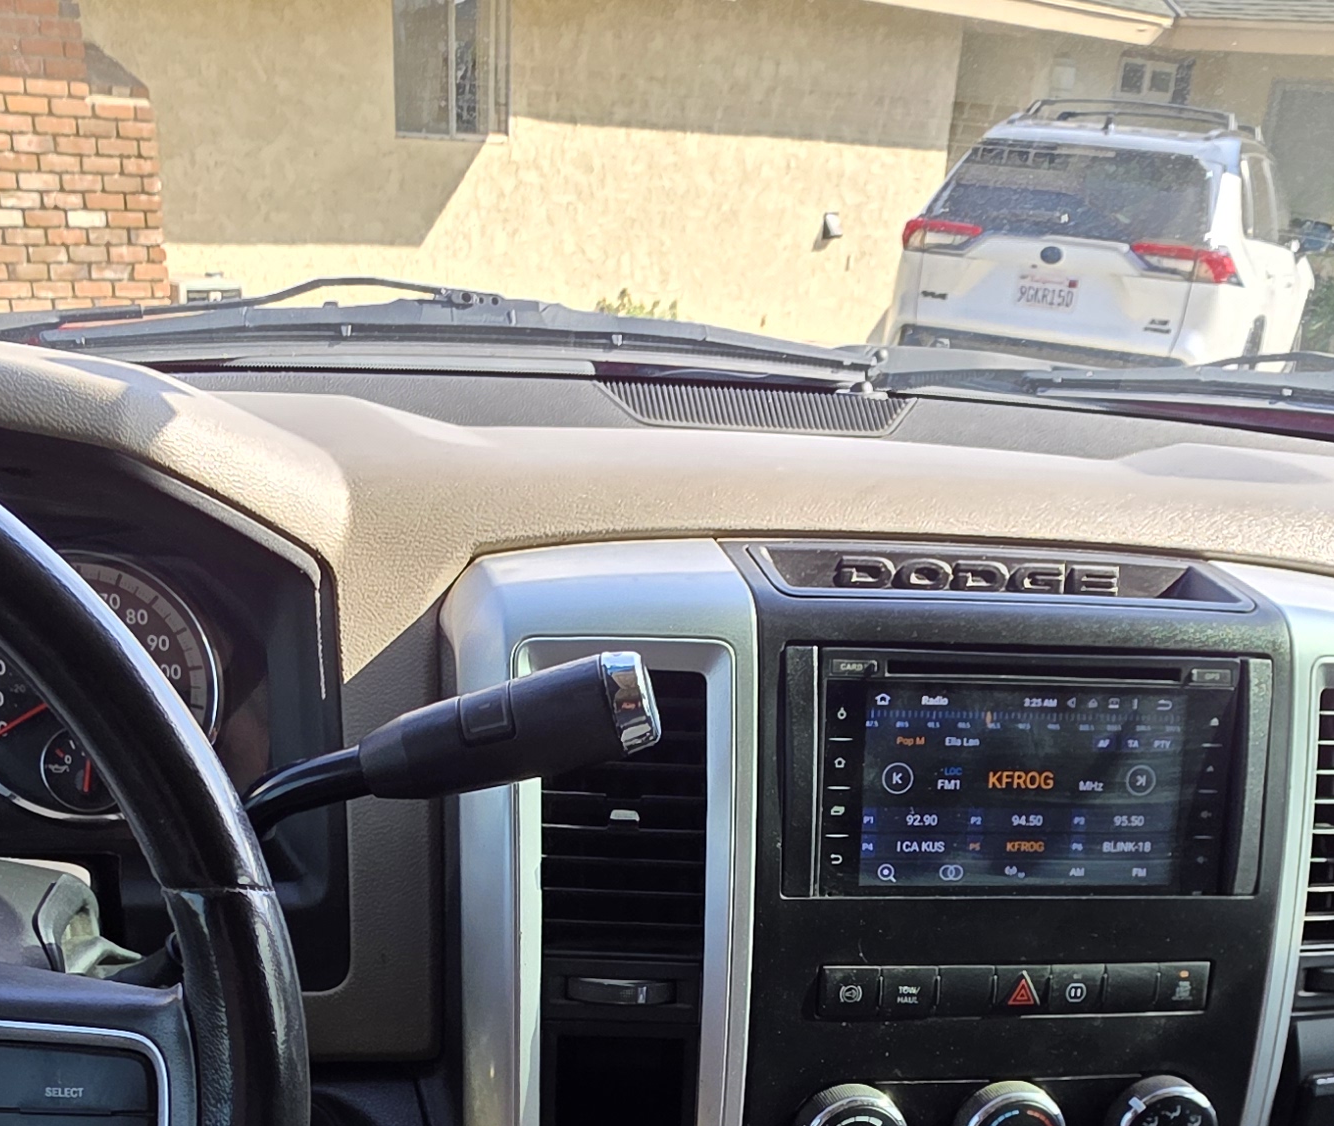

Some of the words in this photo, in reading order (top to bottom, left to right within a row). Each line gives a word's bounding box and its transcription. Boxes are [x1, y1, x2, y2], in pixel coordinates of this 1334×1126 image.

[832, 555, 1119, 596] DODGE
[126, 608, 148, 625] 80
[147, 634, 170, 651] 90
[160, 664, 182, 680] 00
[840, 663, 863, 671] CARD
[921, 695, 949, 706] Radio
[896, 736, 914, 746] Pop
[915, 736, 925, 745] M
[1127, 739, 1139, 748] TA
[944, 767, 963, 776] LOC
[937, 779, 961, 790] FM1
[988, 771, 1054, 790] KFROG
[1079, 780, 1104, 792] MHz
[863, 815, 874, 824] P1
[906, 814, 938, 826] 92.90
[970, 816, 982, 825] P2
[1011, 814, 1043, 827] 94.50
[1113, 815, 1145, 827] 95.50
[862, 843, 873, 851] P4
[902, 841, 919, 852] CA
[921, 841, 945, 852] KUS
[969, 842, 981, 851] P5
[1006, 841, 1045, 852] KFROG
[1102, 841, 1152, 853] BLINK-18
[1069, 867, 1085, 877] AM
[1132, 868, 1147, 877] FM
[897, 996, 919, 1004] HAUL
[44, 1086, 84, 1098] SELECT
